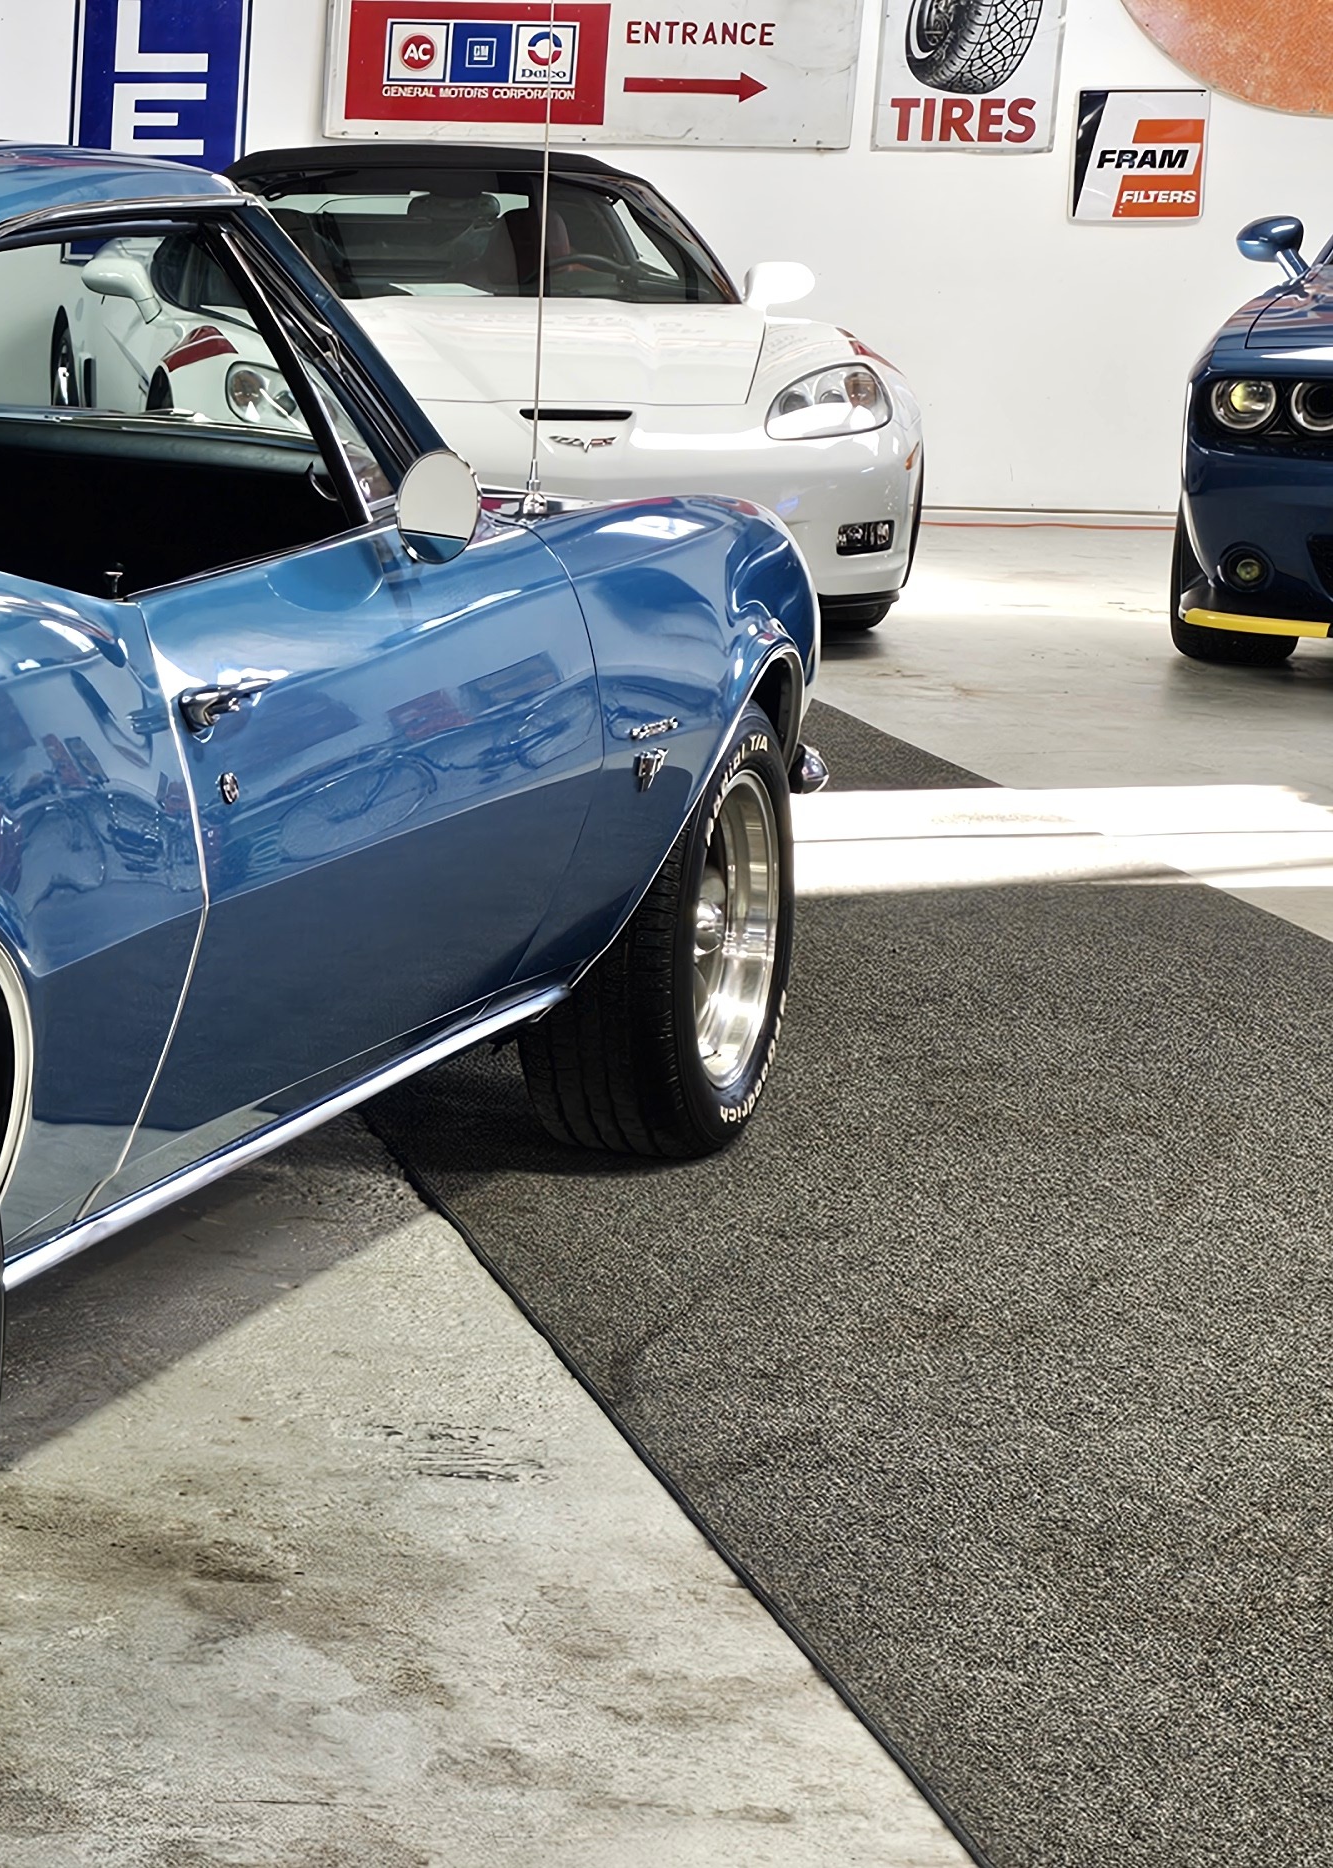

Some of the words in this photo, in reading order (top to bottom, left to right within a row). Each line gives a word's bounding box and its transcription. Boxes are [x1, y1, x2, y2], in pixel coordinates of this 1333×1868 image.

[626, 20, 776, 46] ENTRANCE
[403, 43, 432, 61] AC
[382, 86, 436, 98] GENERAL
[439, 87, 489, 98] MOTORS
[492, 88, 576, 100] CORPORATION
[891, 97, 1037, 143] TIRES
[1096, 149, 1189, 169] FRAM
[1120, 190, 1197, 204] FILTERS
